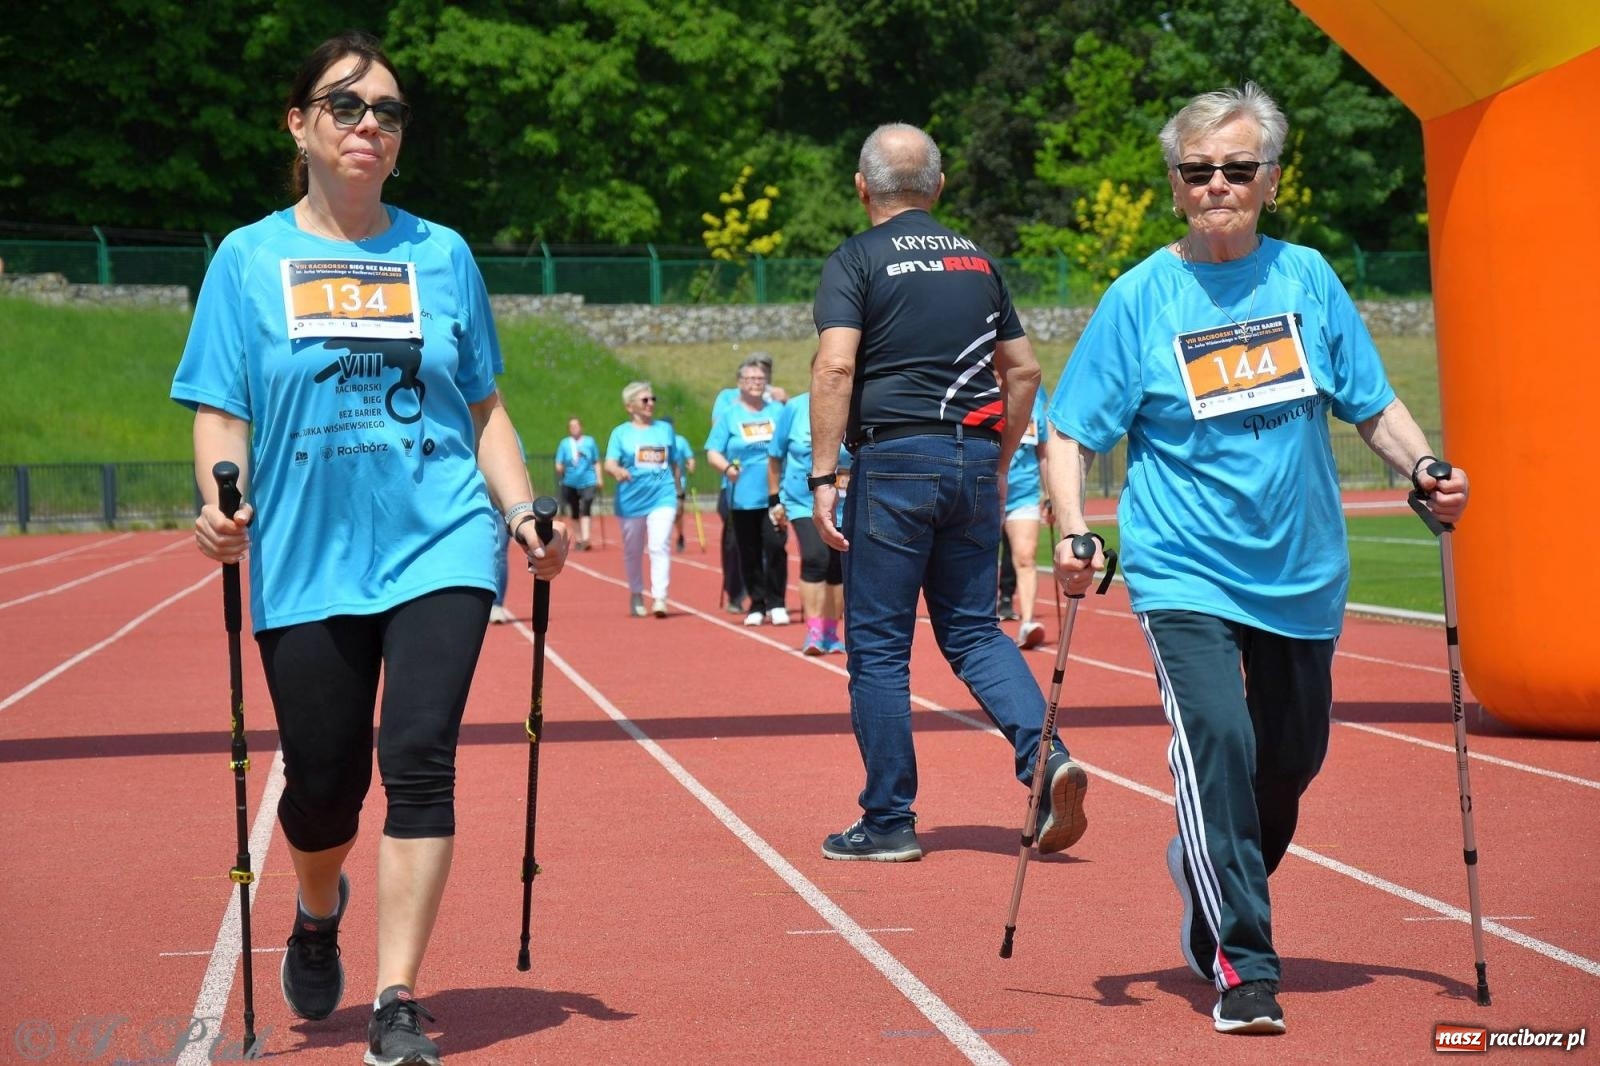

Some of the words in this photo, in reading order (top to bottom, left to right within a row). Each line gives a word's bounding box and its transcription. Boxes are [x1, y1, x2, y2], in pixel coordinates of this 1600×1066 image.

[892, 235, 977, 252] KRYSTIAN
[322, 283, 388, 313] 134
[1197, 330, 1234, 342] RACIBORSKI
[338, 352, 383, 380] VIII
[1213, 346, 1277, 385] 144
[335, 383, 382, 395] RACIBORSKI
[363, 395, 382, 404] BIEG
[339, 409, 353, 419] BEZ
[354, 408, 382, 417] BARIER
[324, 420, 384, 434] WIŚNIEWSKIEGO
[337, 442, 388, 456] Racibórz
